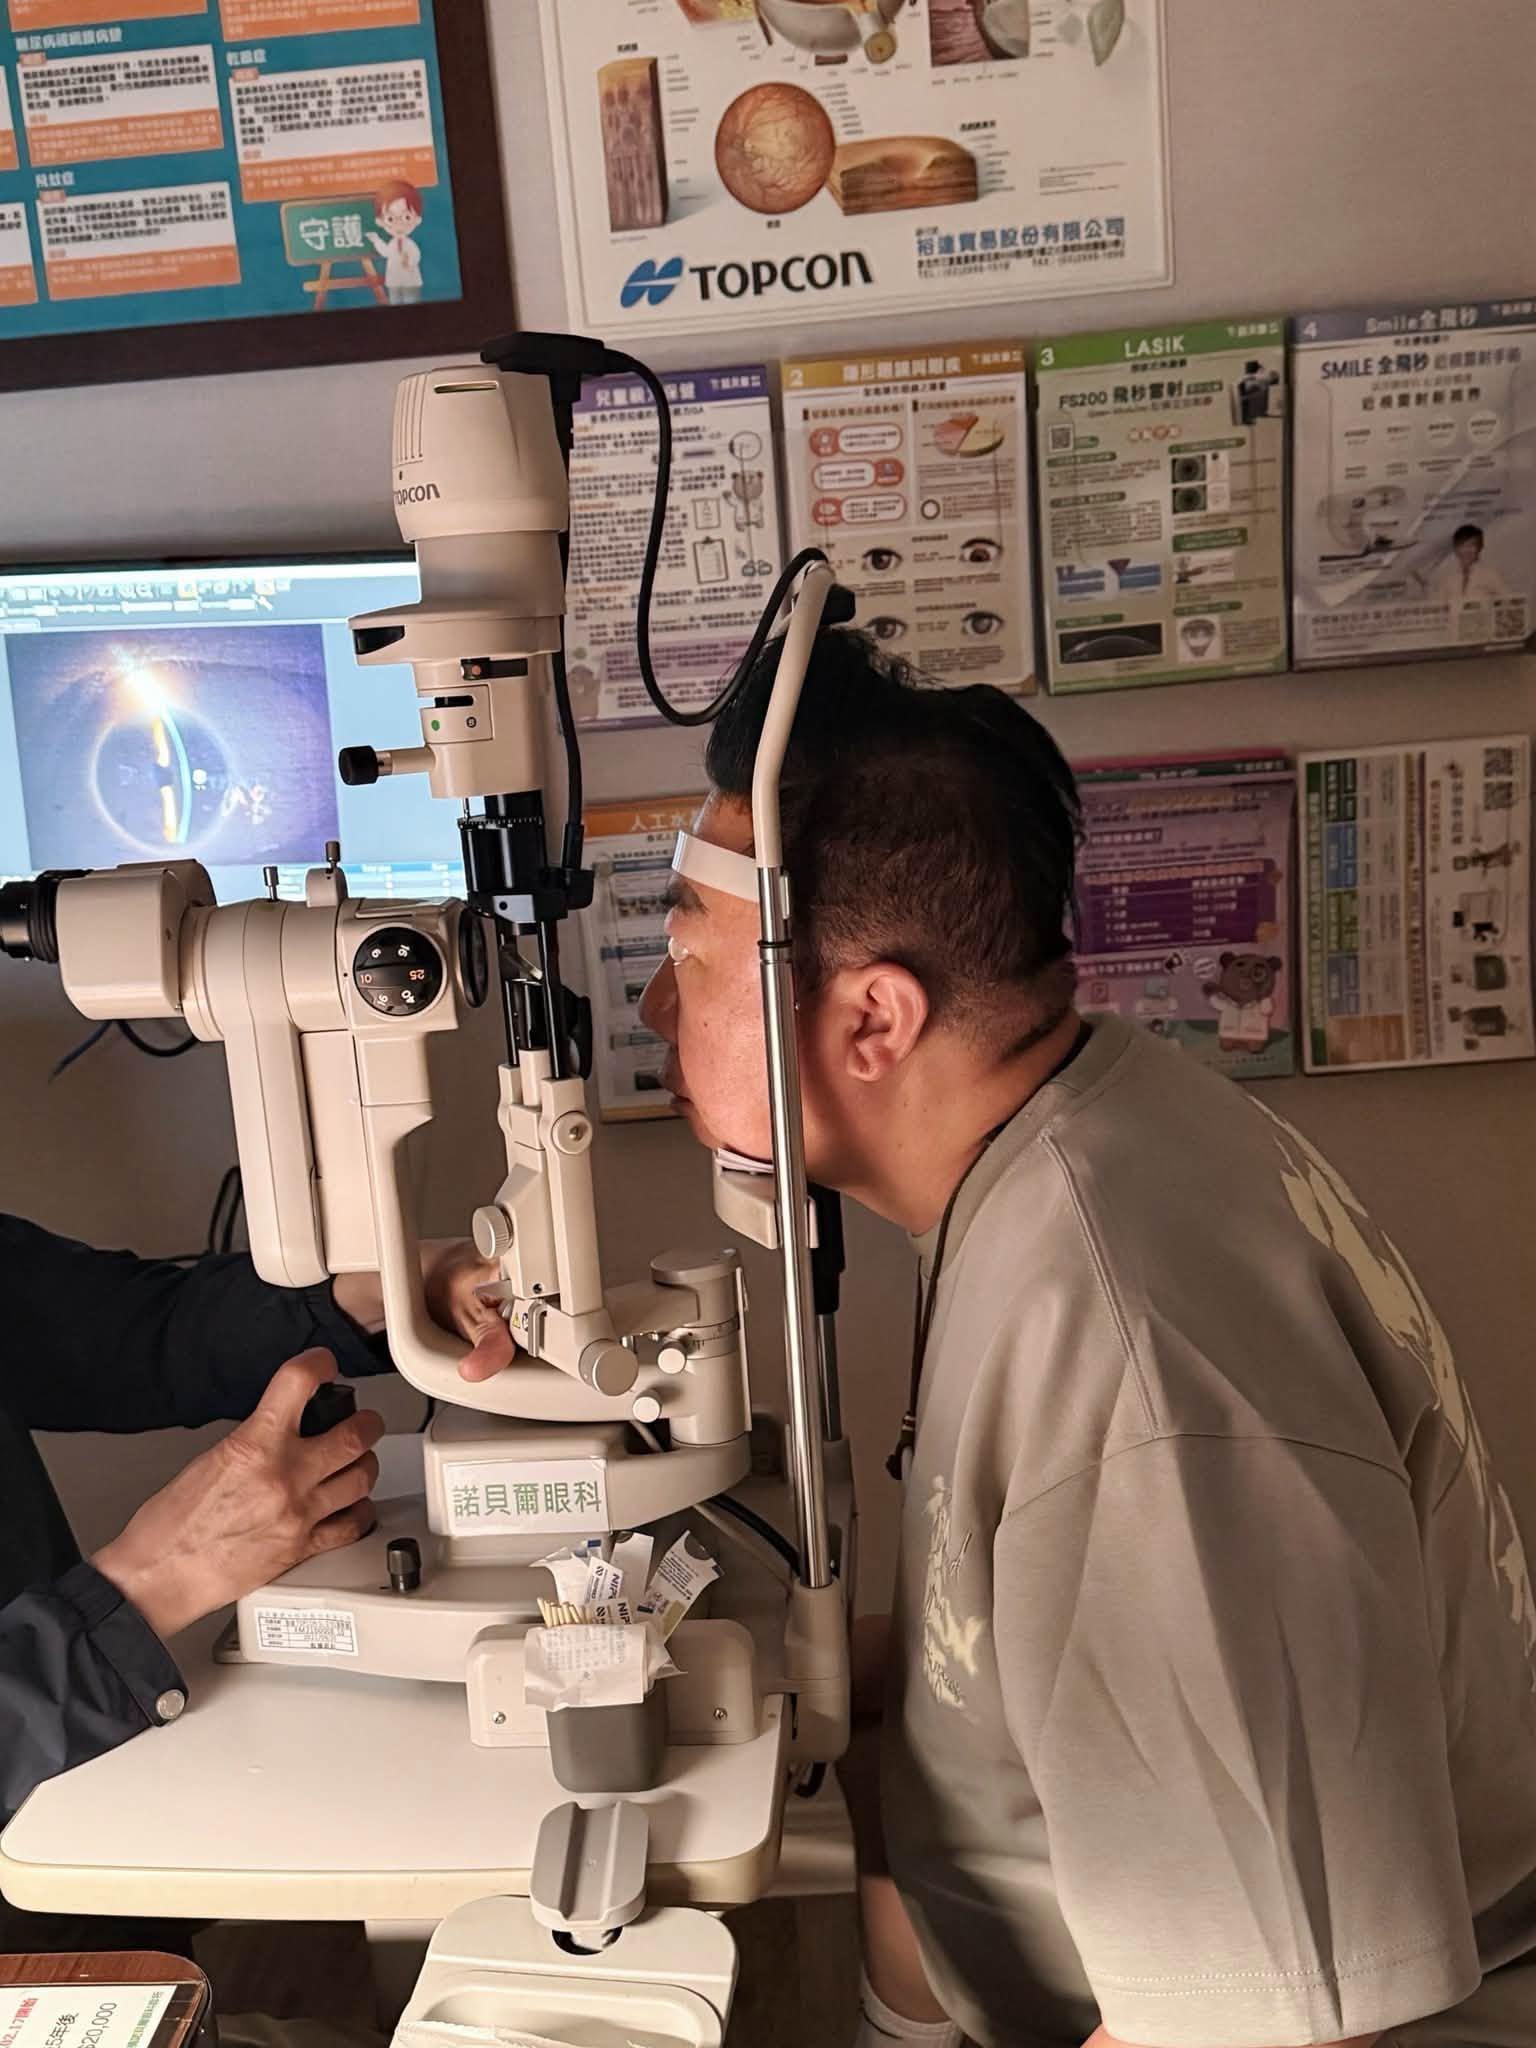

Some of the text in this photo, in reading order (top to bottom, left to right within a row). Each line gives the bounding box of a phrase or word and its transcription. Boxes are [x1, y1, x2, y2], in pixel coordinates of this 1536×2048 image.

[299, 214, 364, 252] 守護
[917, 218, 1125, 257] 裕達貿易股份有限公司
[689, 251, 874, 301] TOPCON
[1304, 321, 1317, 338] 4
[1041, 348, 1054, 366] 3
[1125, 336, 1184, 358] LASIK
[790, 370, 803, 386] 2
[1321, 359, 1373, 380] SMILE
[1059, 391, 1107, 409] FS200
[371, 949, 381, 958] 6
[398, 945, 410, 957] 16
[360, 974, 372, 984] 10
[409, 969, 425, 980] 25
[401, 990, 415, 1004] 40
[452, 1481, 601, 1517] 諾貝爾眼科
[45, 2012, 79, 2048] 5年後
